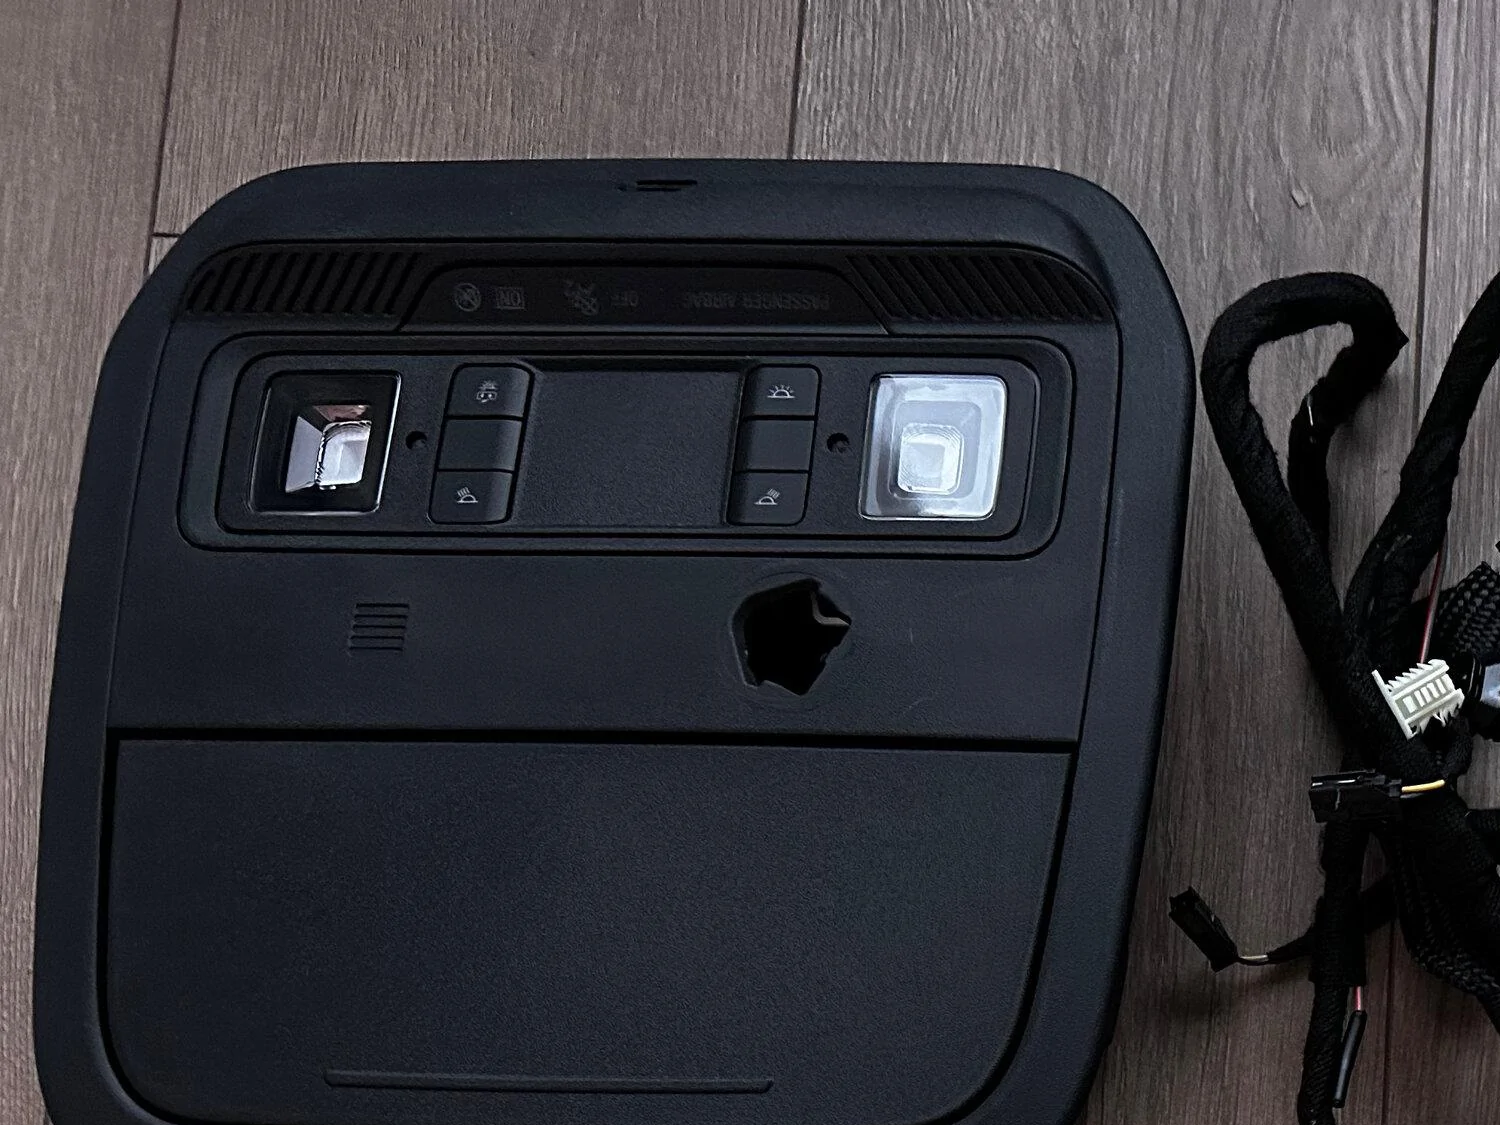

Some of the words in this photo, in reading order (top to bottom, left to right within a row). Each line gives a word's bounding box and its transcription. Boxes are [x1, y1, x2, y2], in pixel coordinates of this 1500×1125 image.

[499, 289, 522, 307] ON
[684, 290, 737, 309] AIRBAG
[743, 290, 830, 310] PASSENGER
